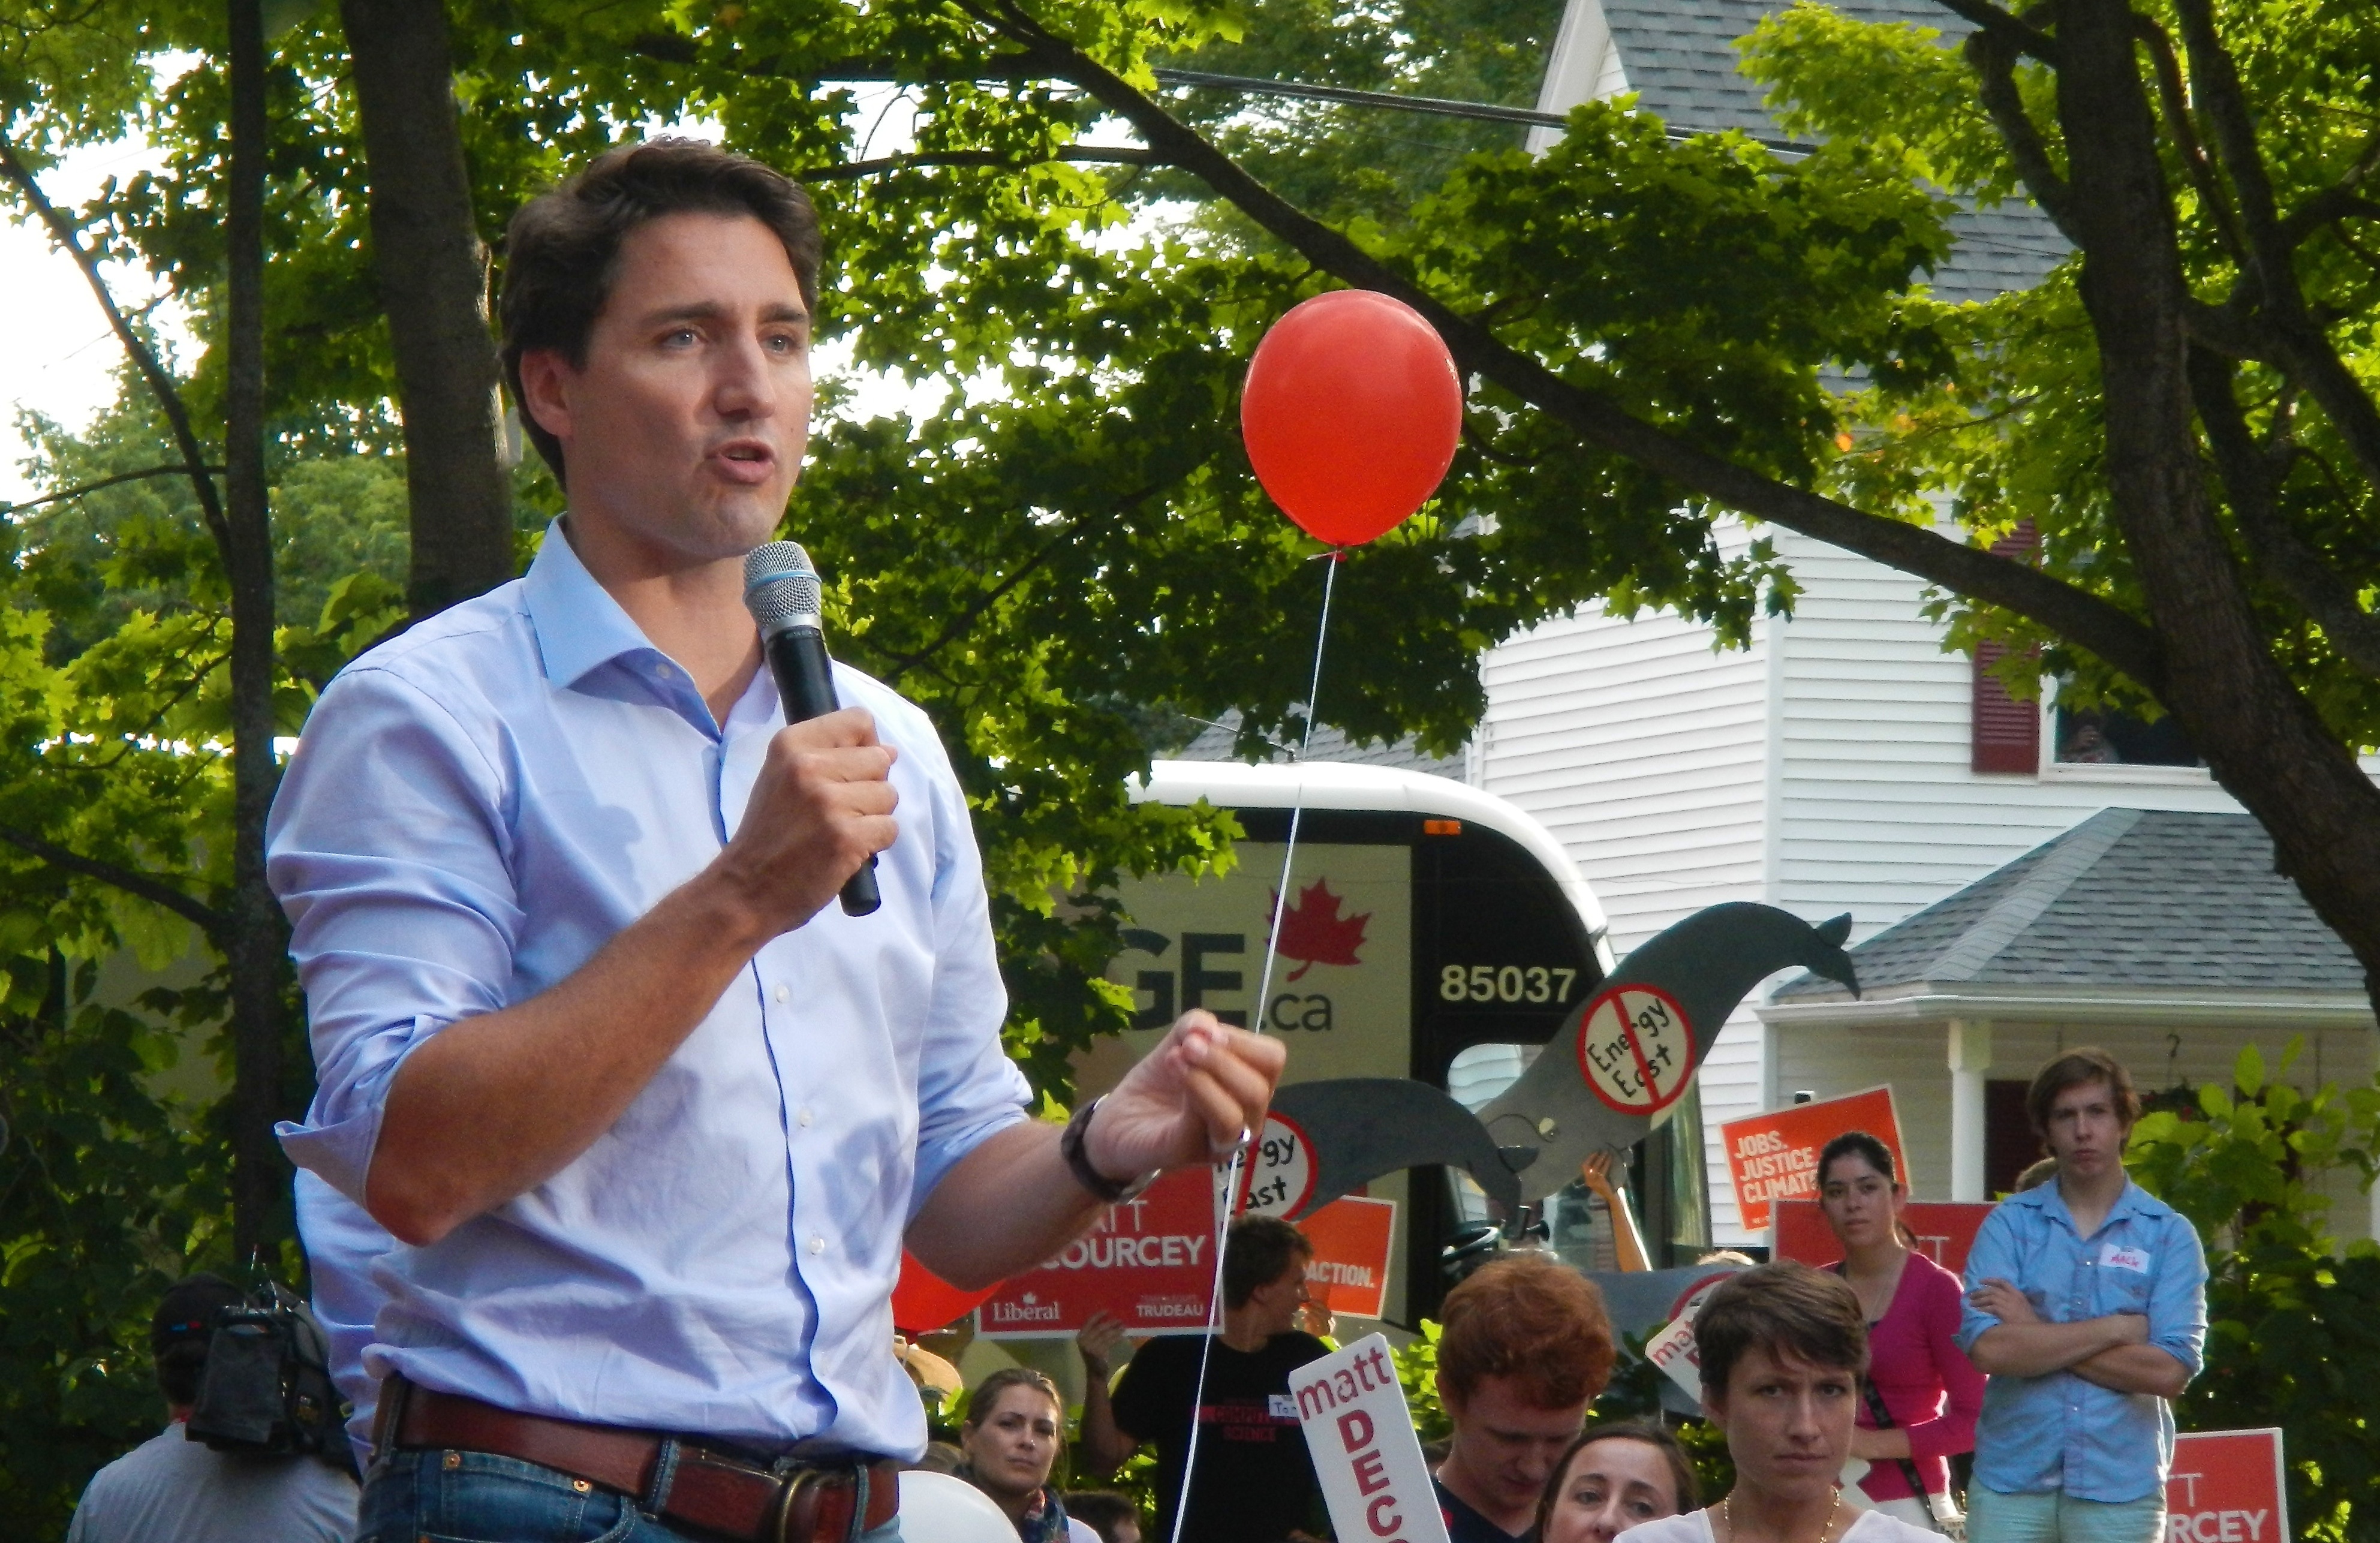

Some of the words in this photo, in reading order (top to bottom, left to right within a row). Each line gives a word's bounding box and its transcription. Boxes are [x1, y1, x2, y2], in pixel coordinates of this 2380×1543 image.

[1440, 964, 1576, 1003] 85037
[1734, 1130, 1788, 1159] JOBS.
[1041, 1235, 1206, 1270] OURCEY
[1304, 1261, 1374, 1288] ACTION.
[994, 1301, 1060, 1321] Liberal
[1136, 1304, 1205, 1318] TRUDEAU
[1296, 1346, 1391, 1421] matt
